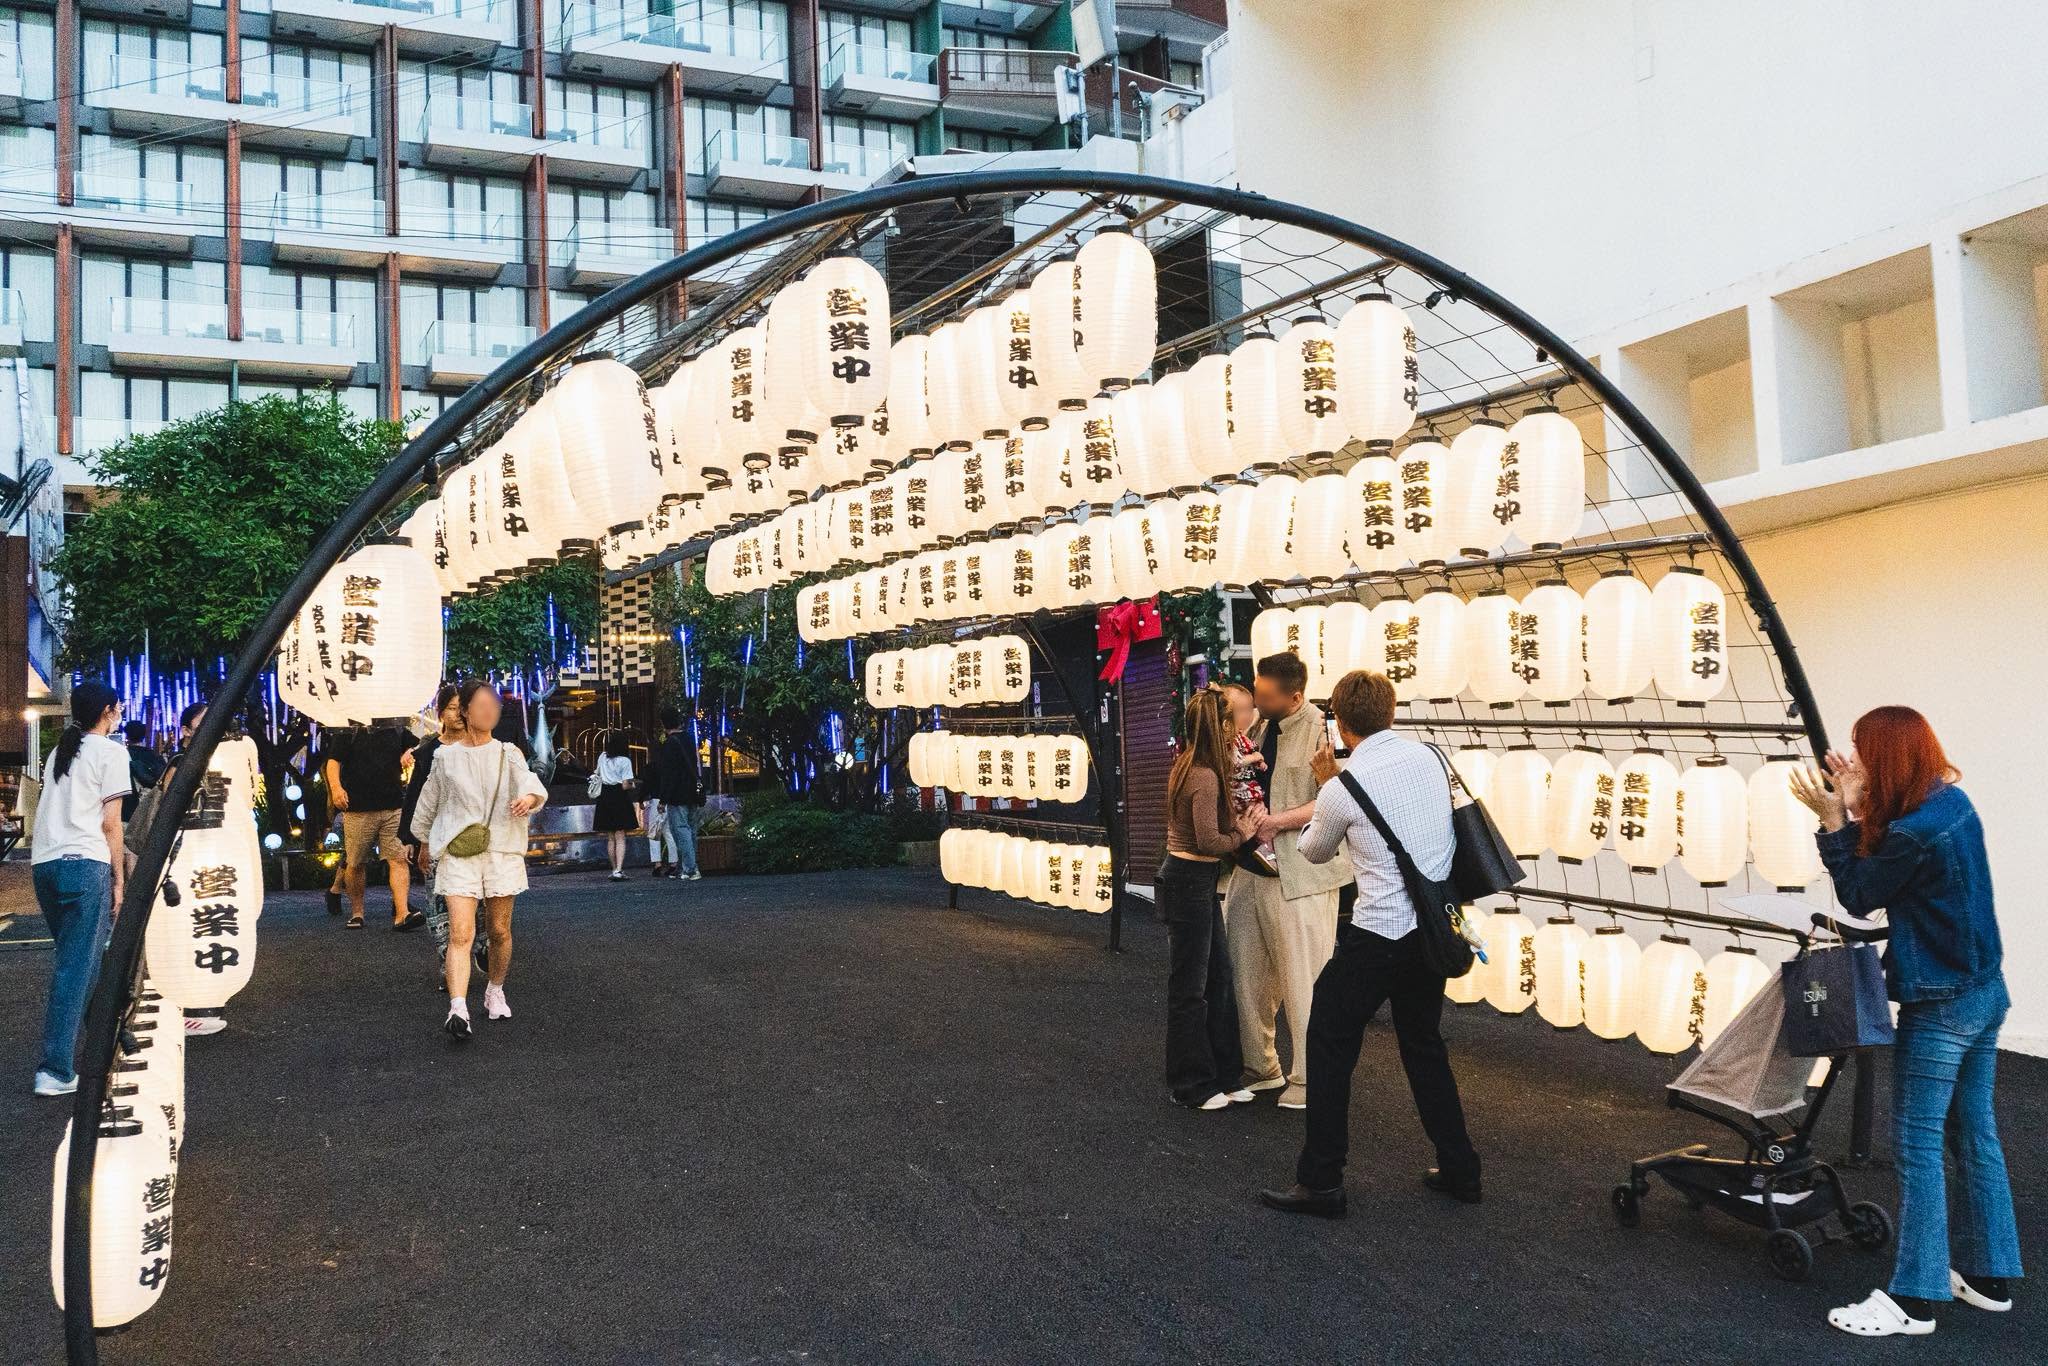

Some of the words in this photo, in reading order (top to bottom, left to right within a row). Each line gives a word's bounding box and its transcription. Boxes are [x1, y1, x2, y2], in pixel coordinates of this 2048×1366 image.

[826, 286, 871, 384] 營業中
[1301, 338, 1337, 418] 營業中
[1004, 437, 1025, 498] 營業中
[1083, 418, 1113, 483] 營業中
[502, 452, 529, 537] 營業中
[907, 478, 928, 529] 營業中
[1362, 481, 1395, 550] 營業中
[1401, 460, 1433, 533] 營業中
[849, 502, 864, 549] 營業中
[1185, 504, 1210, 562] 營業中
[943, 559, 957, 603] 營業中
[966, 555, 982, 600] 營業中
[1013, 549, 1034, 597] 營業中
[341, 574, 382, 682] 營業中
[1384, 622, 1411, 683] 營業中
[1690, 601, 1720, 680] 營業中
[957, 651, 971, 691] 營業中
[1004, 648, 1023, 689] 營業中
[978, 749, 992, 787] 營業中
[1001, 749, 1014, 787] 營業中
[1055, 748, 1071, 790] 營業中
[1590, 773, 1615, 841] 營業中
[1620, 772, 1650, 841] 營業中
[189, 864, 239, 974] 營業中
[140, 1176, 171, 1291] 營業中
